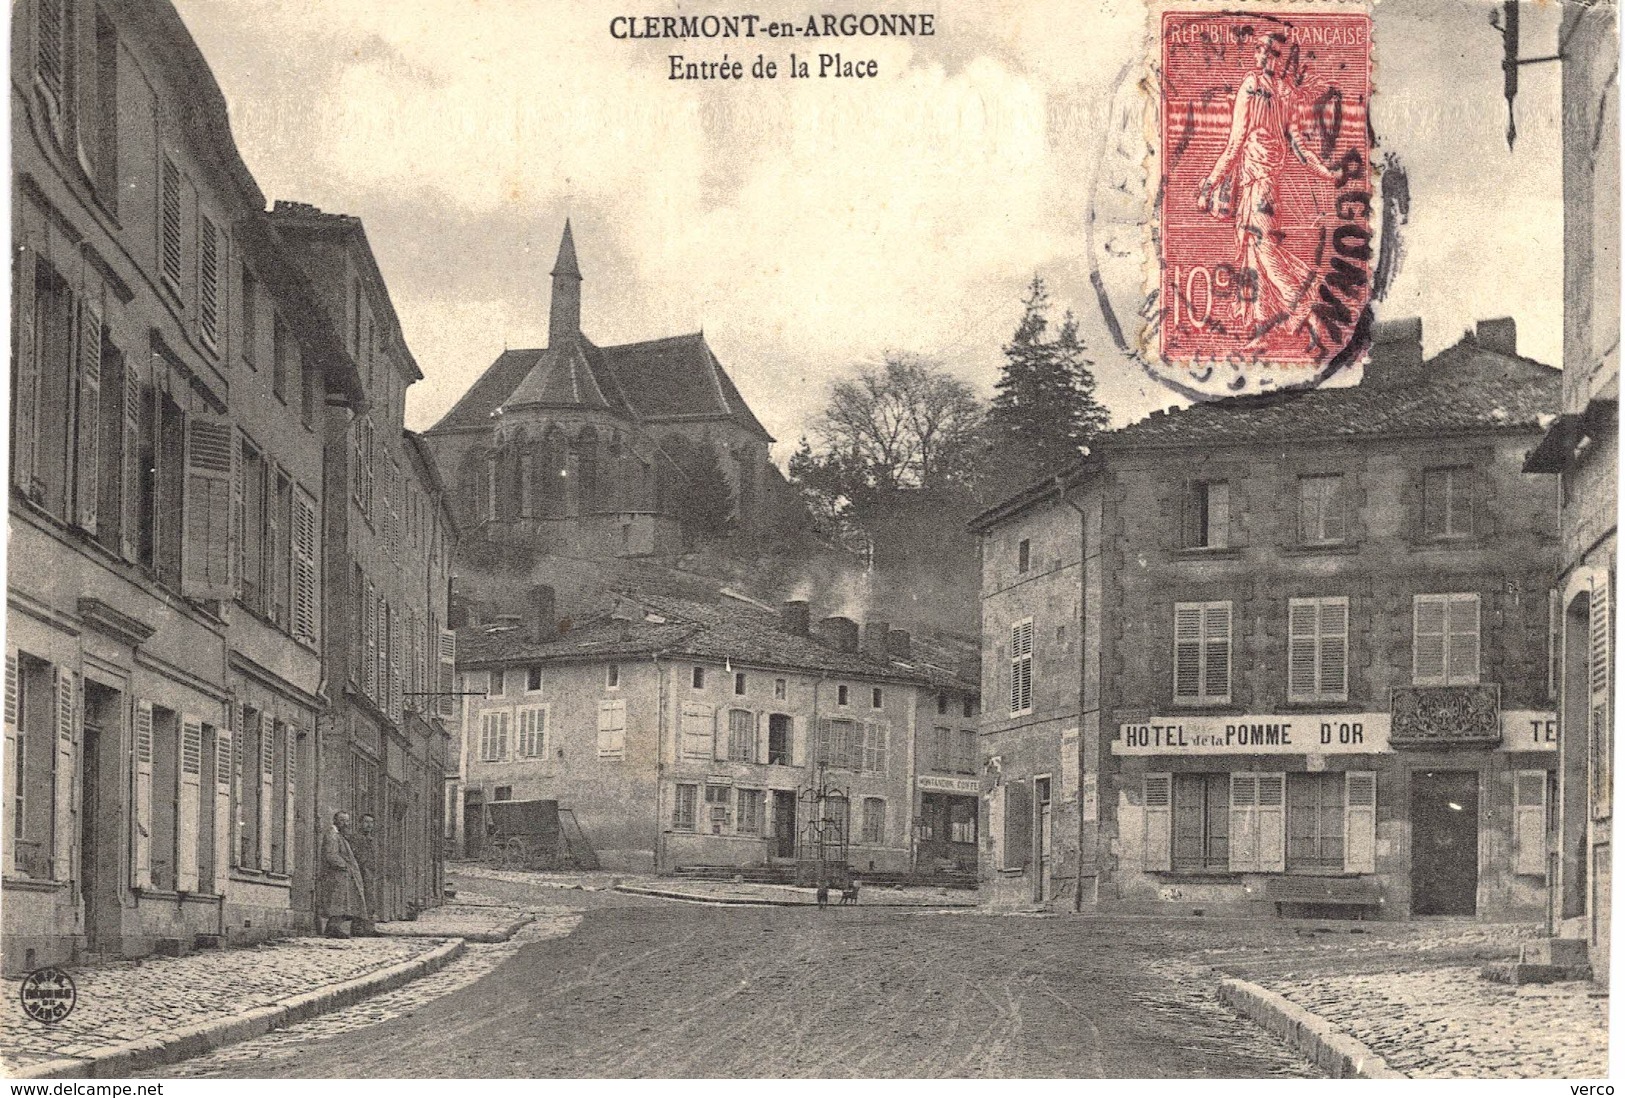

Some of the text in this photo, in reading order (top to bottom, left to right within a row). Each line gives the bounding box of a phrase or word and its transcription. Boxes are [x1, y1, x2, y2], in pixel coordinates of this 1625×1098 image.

[1126, 725, 1188, 747] HOTEL
[1192, 735, 1208, 747] de
[1211, 734, 1224, 747] la
[1225, 723, 1292, 746] POMME
[1320, 721, 1364, 744] D'OR
